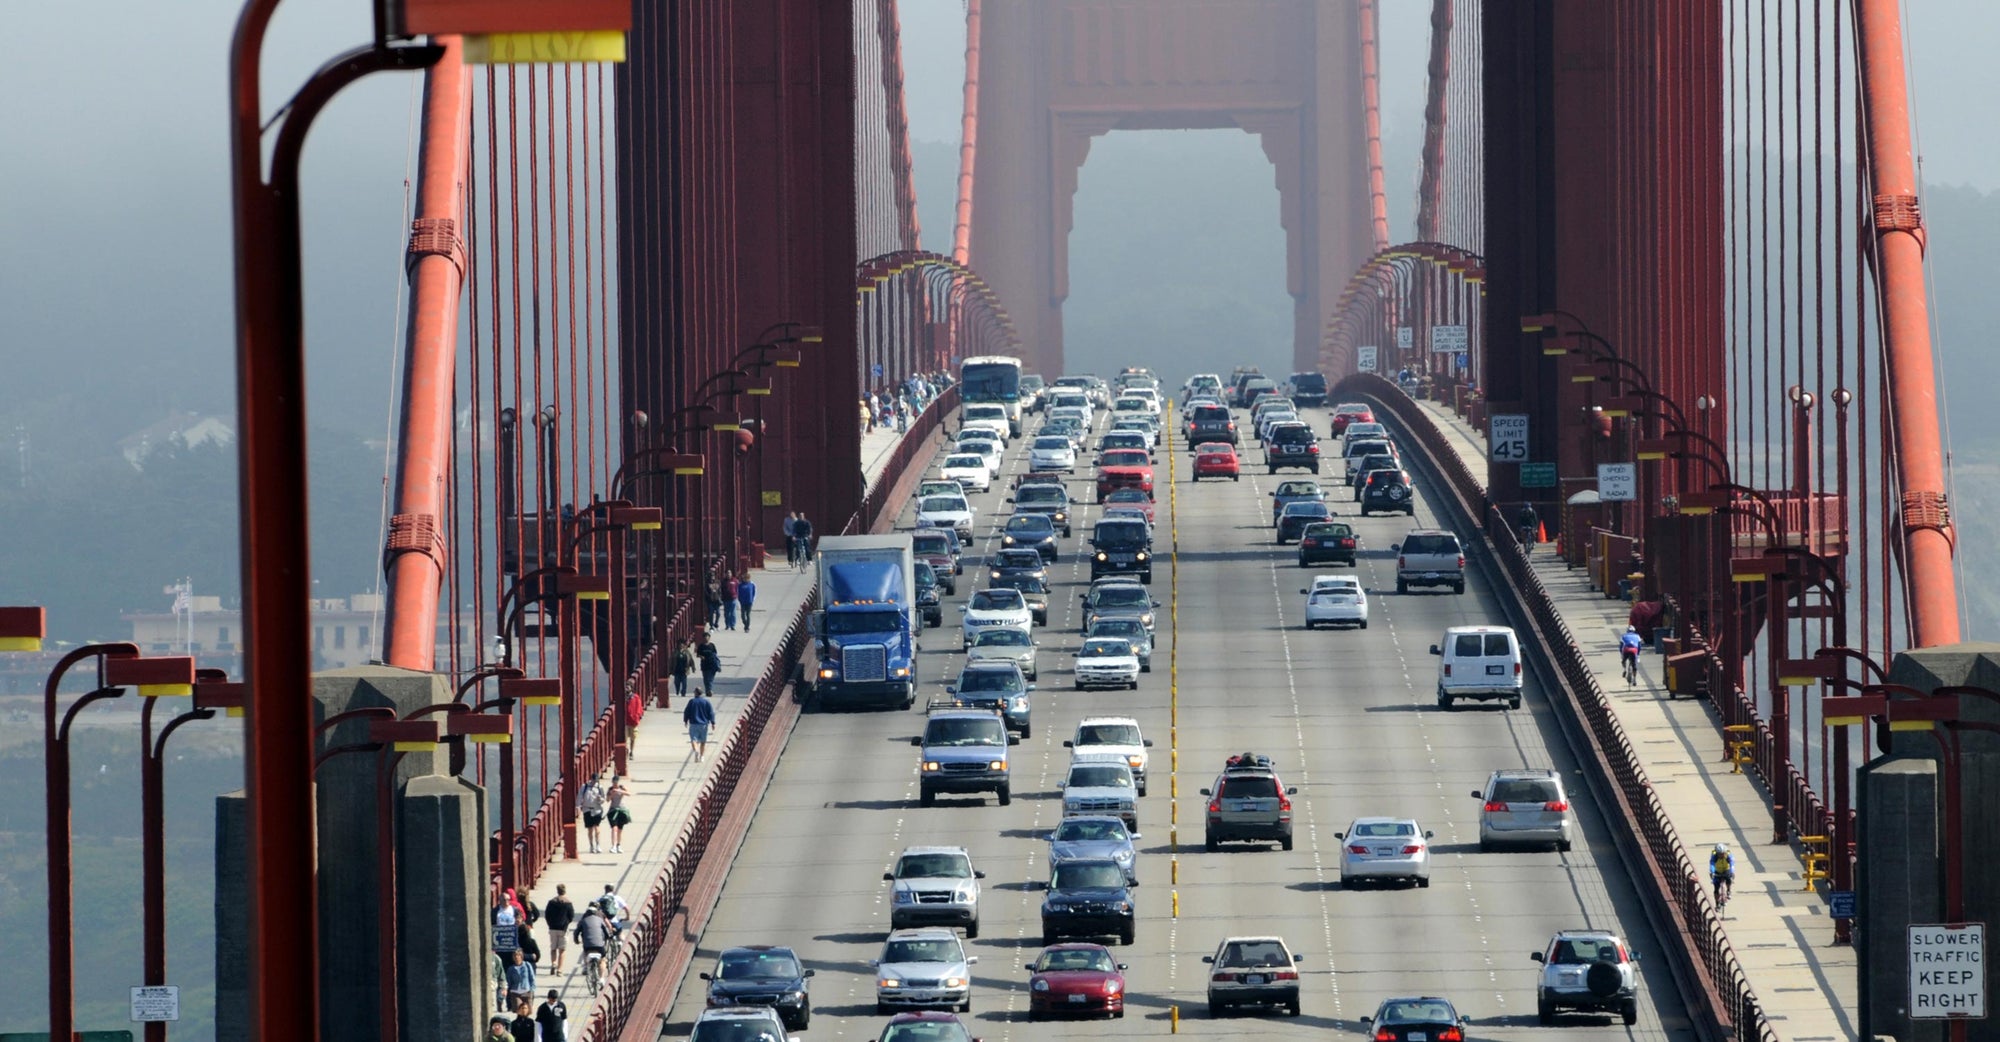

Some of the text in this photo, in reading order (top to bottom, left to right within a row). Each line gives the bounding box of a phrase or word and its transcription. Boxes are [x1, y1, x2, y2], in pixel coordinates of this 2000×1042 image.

[1493, 419, 1526, 428] SPEED
[1496, 430, 1523, 438] LIMIT
[1494, 440, 1526, 459] 45
[1913, 933, 1980, 945] SLOWER
[1913, 951, 1980, 963] TRAFFIC
[1919, 970, 1974, 985] KEEP
[1918, 993, 1978, 1008] RIGHT
